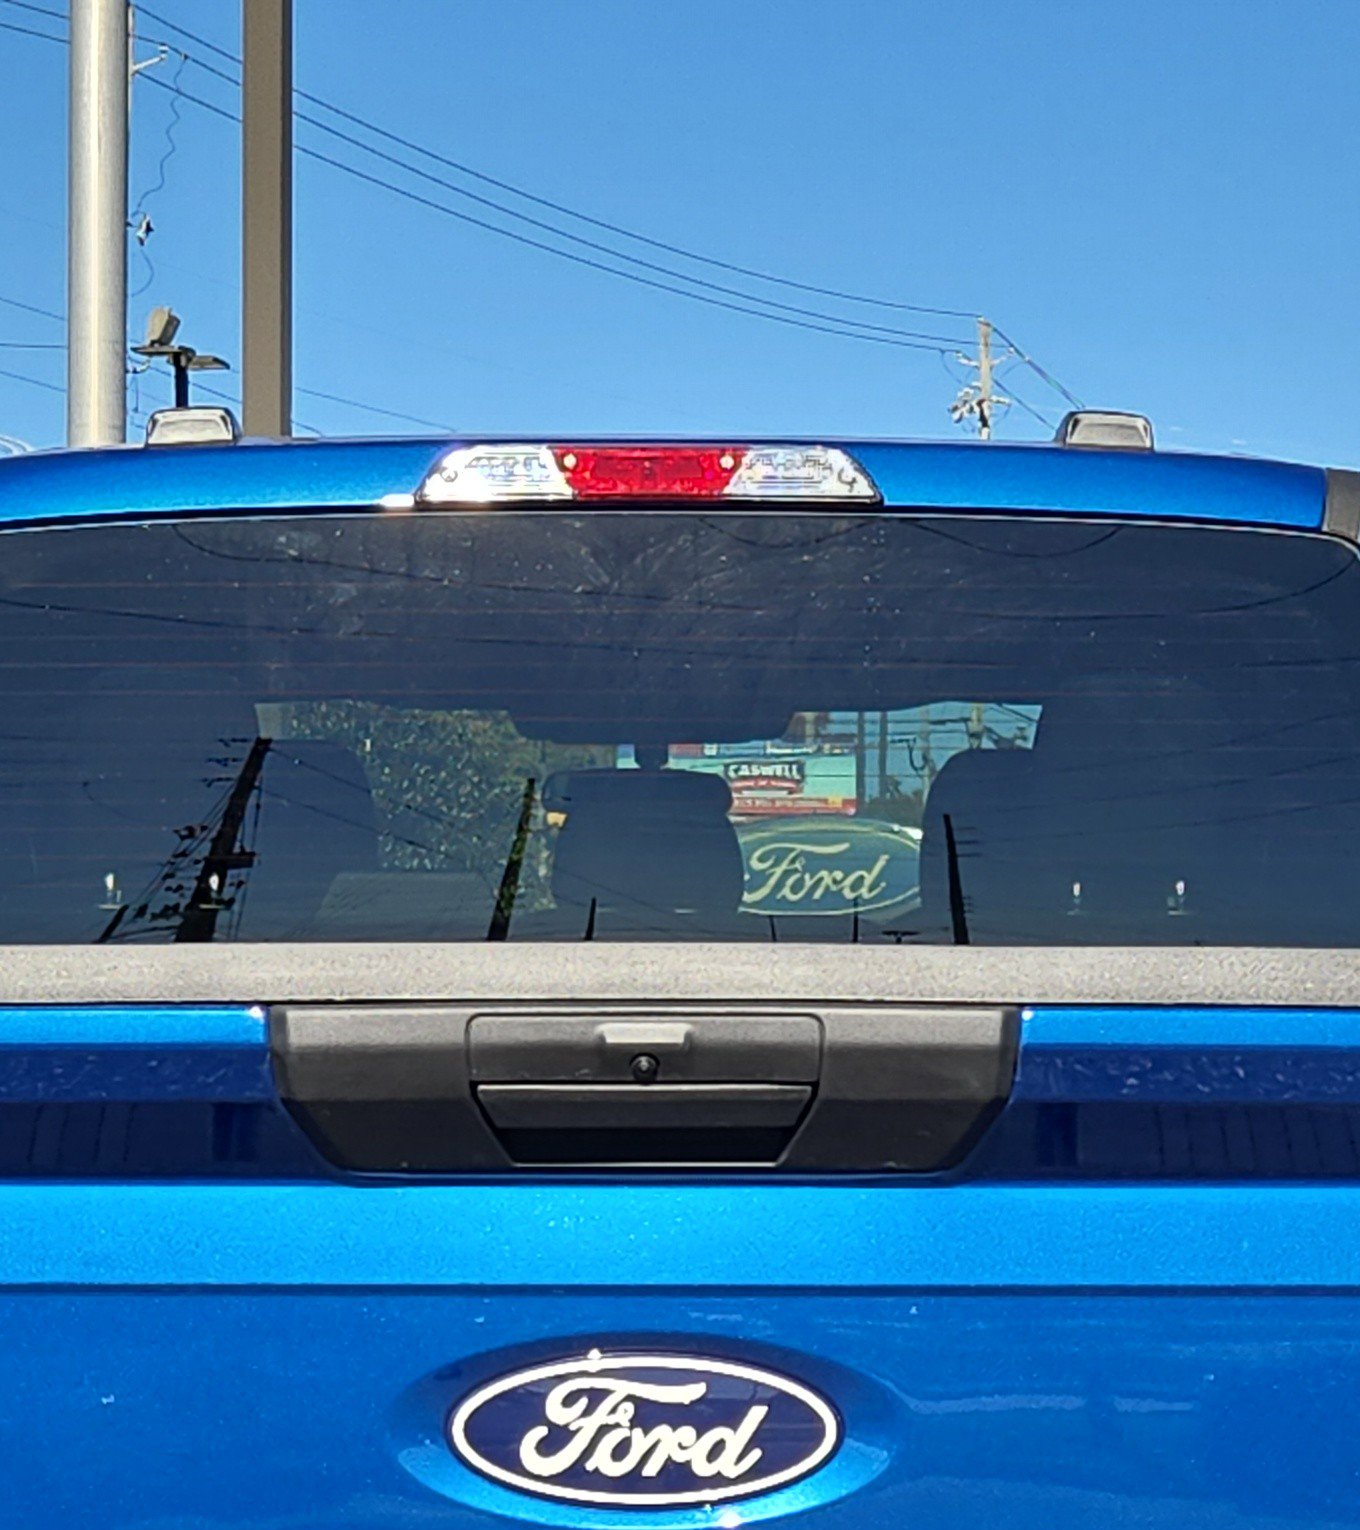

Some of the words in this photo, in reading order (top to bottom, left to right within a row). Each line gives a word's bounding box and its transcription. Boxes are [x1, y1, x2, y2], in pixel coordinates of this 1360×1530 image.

[727, 763, 801, 780] CASWELL
[742, 842, 890, 903] Ford
[519, 1377, 770, 1478] Ford
